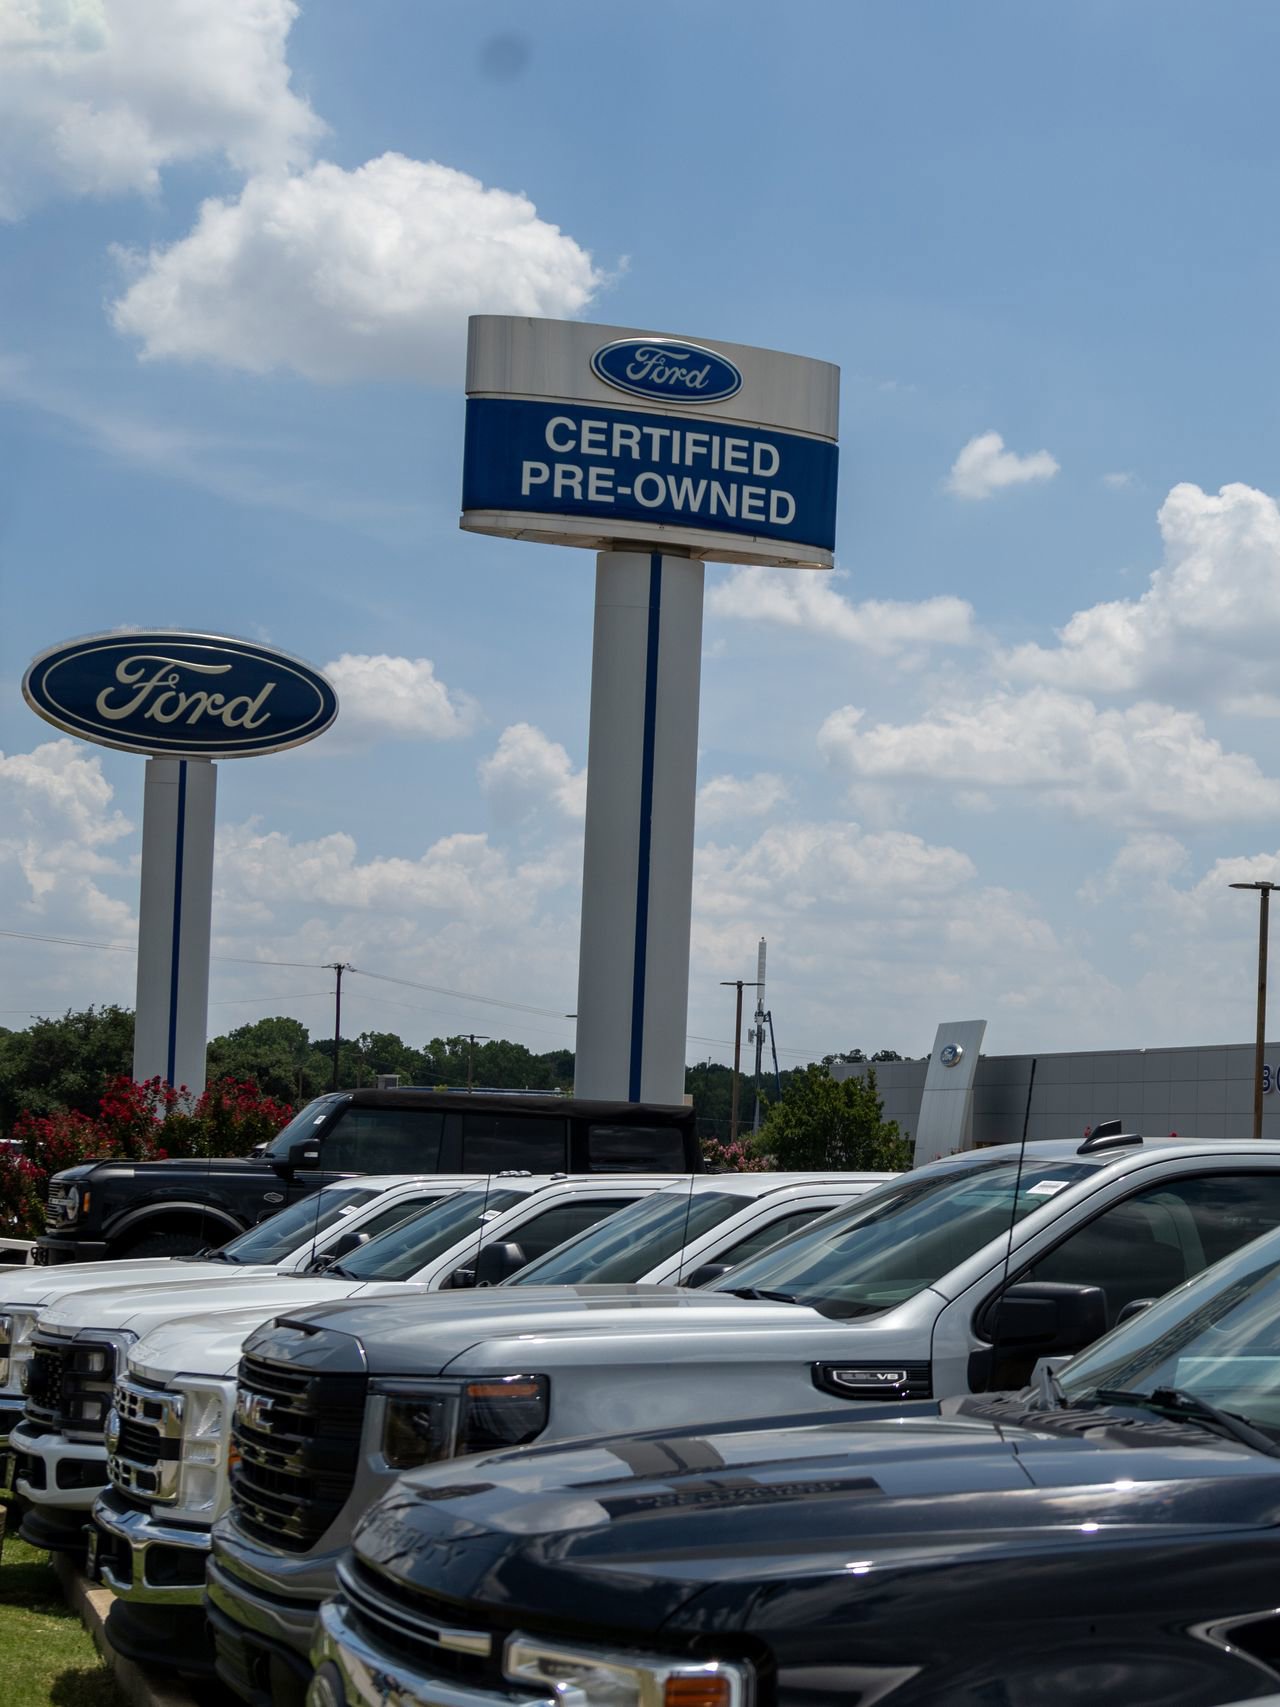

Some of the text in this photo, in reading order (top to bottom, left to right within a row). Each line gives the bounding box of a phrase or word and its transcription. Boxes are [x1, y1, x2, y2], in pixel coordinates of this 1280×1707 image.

[626, 346, 710, 390] Ford
[544, 416, 780, 478] CERTIFIED
[520, 460, 796, 525] PRE-OWNED
[96, 655, 277, 728] Ford
